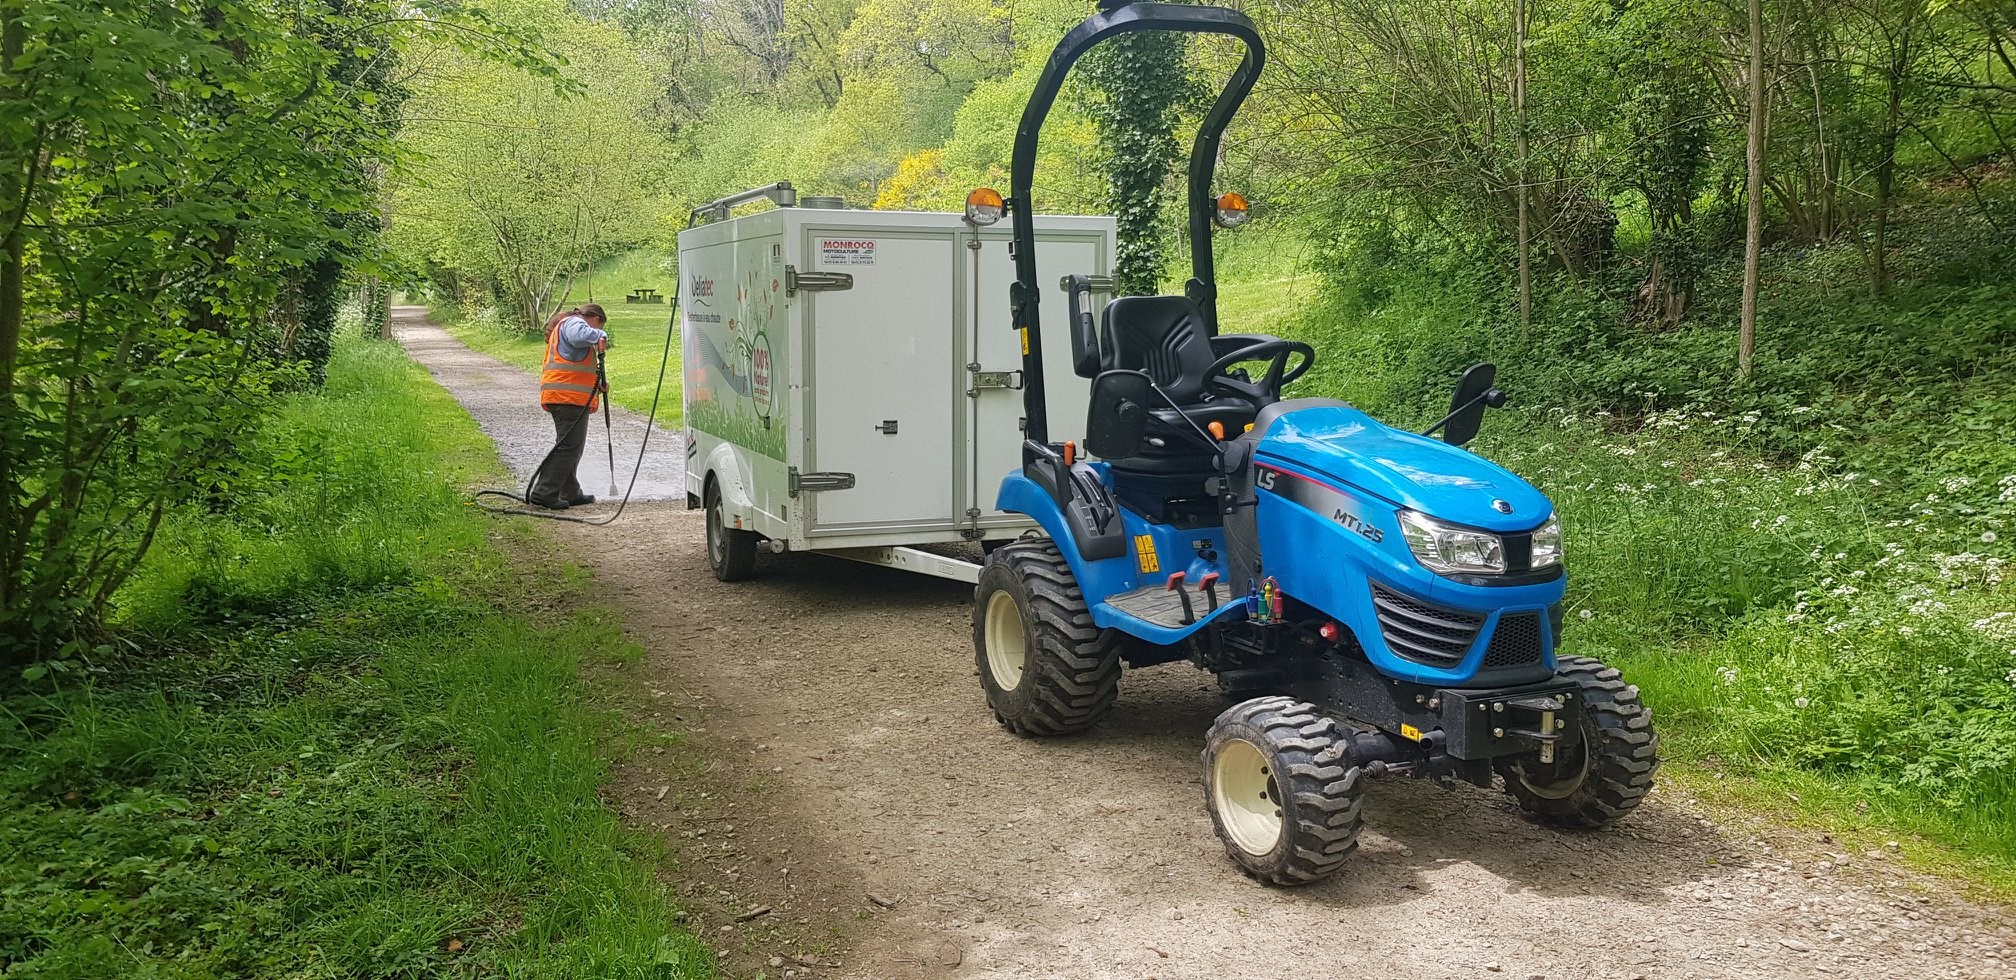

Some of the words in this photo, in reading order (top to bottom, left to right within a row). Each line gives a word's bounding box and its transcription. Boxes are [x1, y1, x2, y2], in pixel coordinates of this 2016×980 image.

[823, 241, 874, 250] MONROCQ
[754, 348, 769, 370] 100%
[1257, 469, 1276, 490] LS
[1334, 508, 1385, 544] MT1.25
